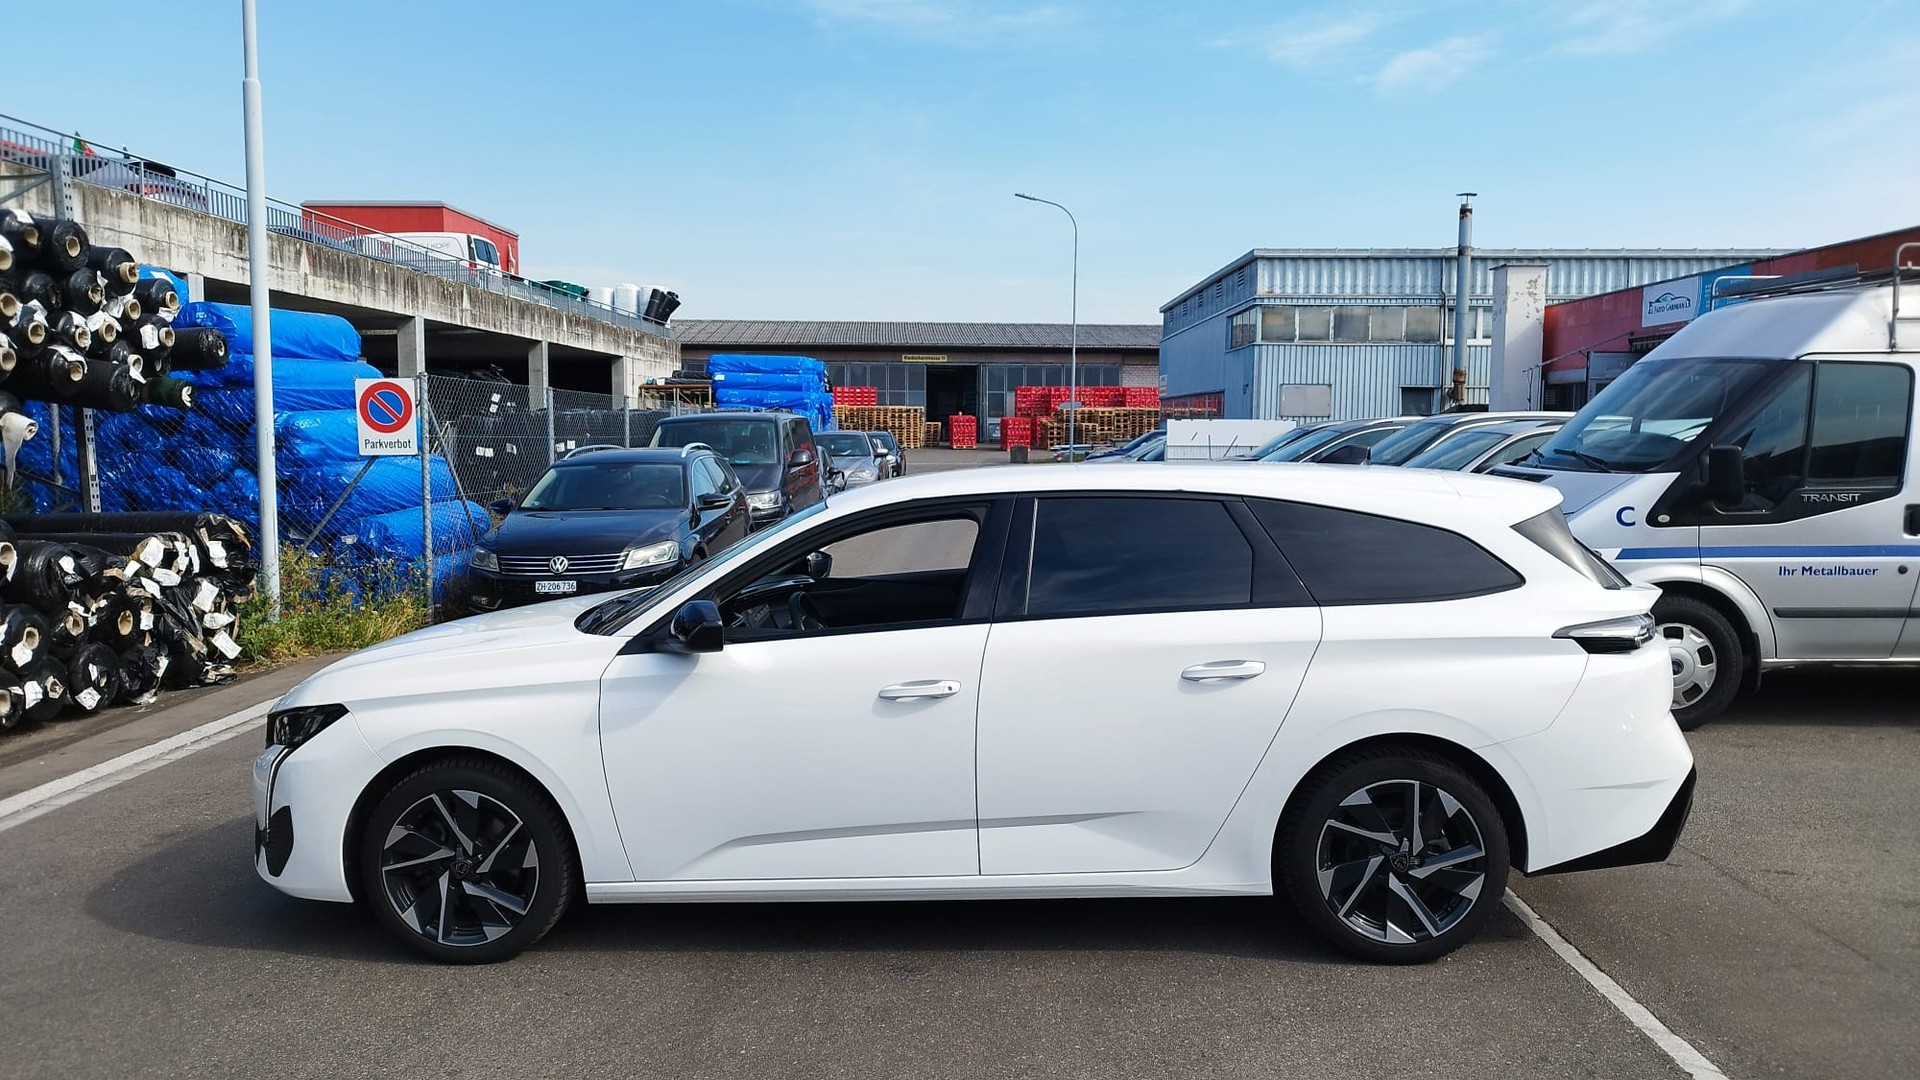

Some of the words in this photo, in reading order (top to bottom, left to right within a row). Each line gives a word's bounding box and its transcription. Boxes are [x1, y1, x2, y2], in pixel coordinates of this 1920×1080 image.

[364, 438, 412, 449] Parkverbot
[1800, 493, 1861, 503] TRANSIT
[1616, 506, 1636, 527] C
[1778, 565, 1797, 577] Ihr
[1801, 565, 1879, 577] Metallbauer
